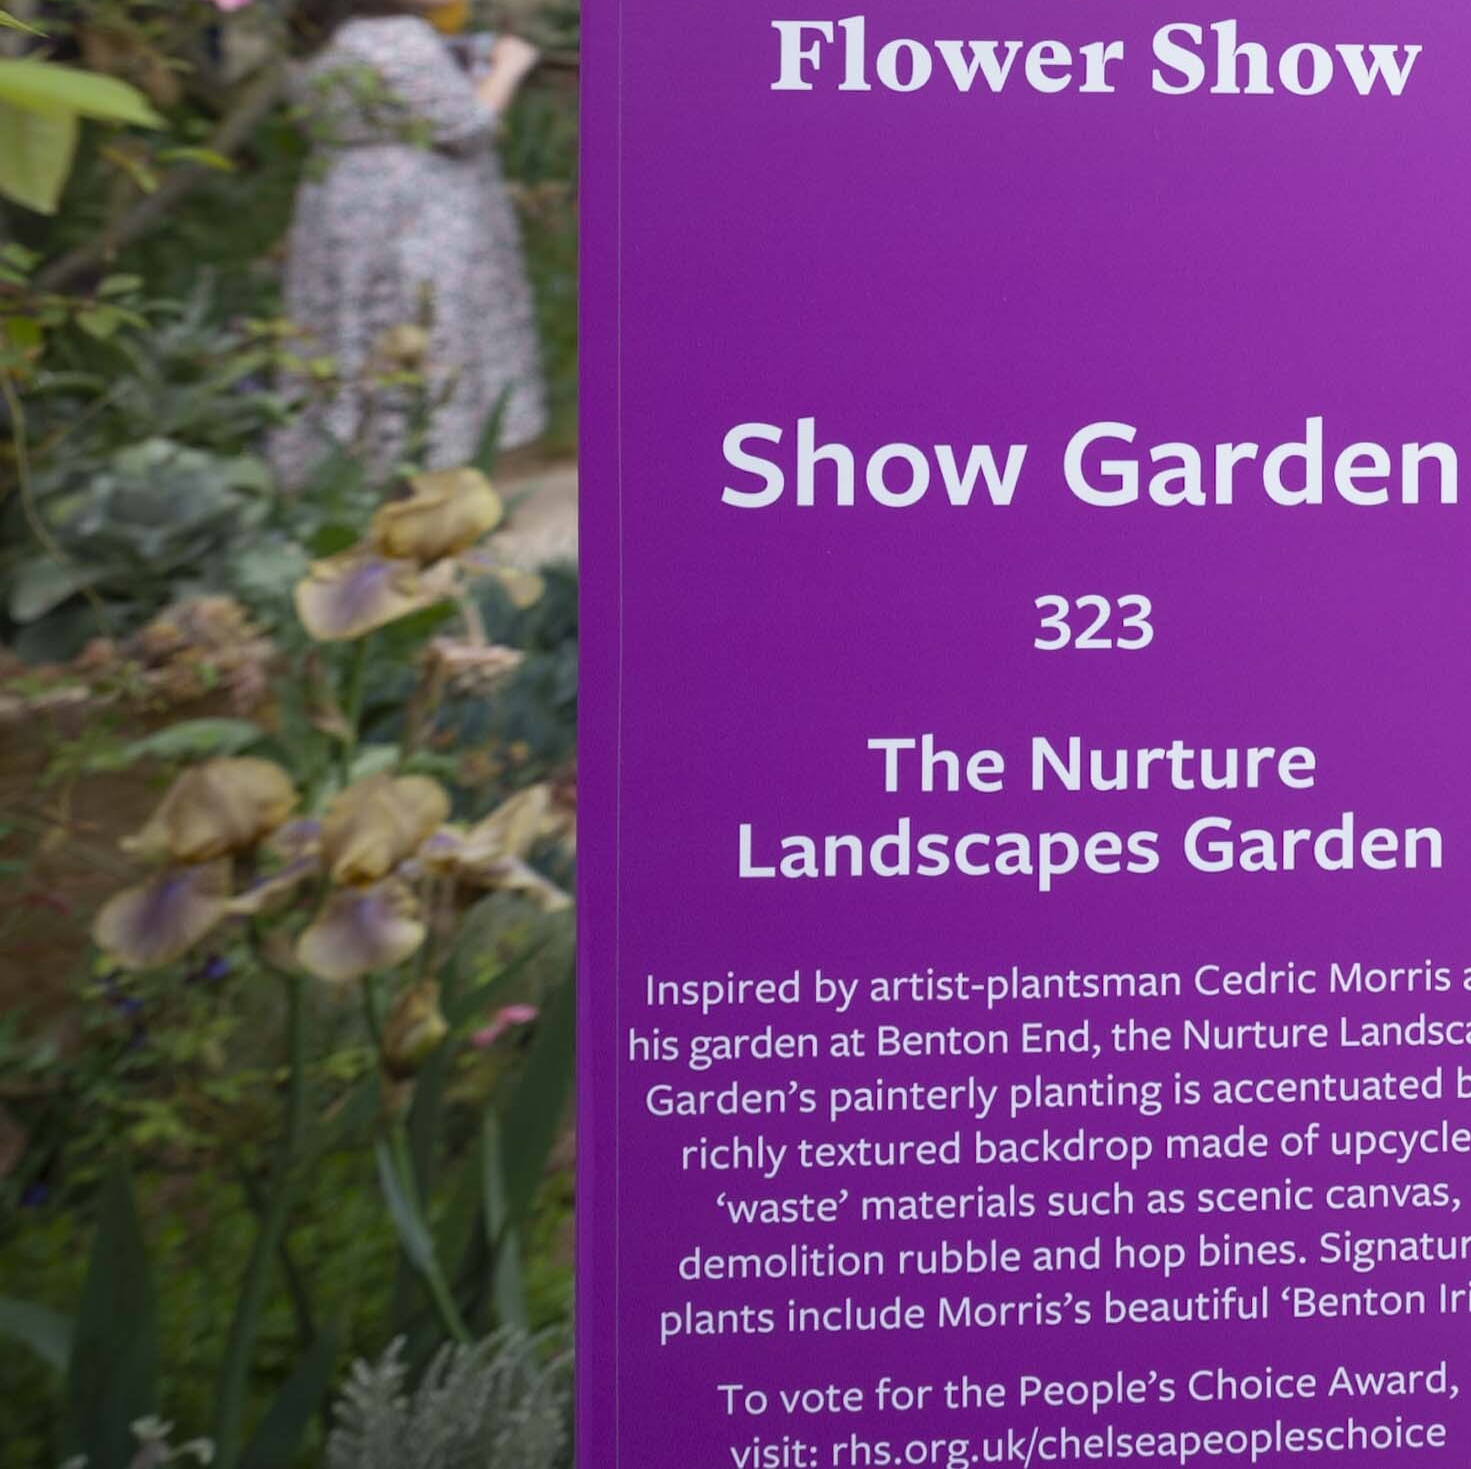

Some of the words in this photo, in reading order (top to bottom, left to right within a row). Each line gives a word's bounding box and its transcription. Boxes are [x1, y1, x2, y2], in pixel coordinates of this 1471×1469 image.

[770, 14, 1125, 94] Flower
[1151, 18, 1423, 97] Show
[720, 416, 1029, 509] Show
[1063, 415, 1458, 508] Garden
[1033, 593, 1155, 651] 323
[867, 732, 1005, 793] The
[1031, 735, 1317, 792] Nurture
[738, 816, 1160, 893] Landscapes
[1183, 810, 1443, 873] Garden
[647, 969, 800, 1016] Inspired
[815, 969, 860, 1013] by
[870, 965, 1181, 1011] artist-plantsman
[1194, 961, 1317, 996] Cedric
[1329, 958, 1452, 993] Morris
[629, 1027, 680, 1062] his
[688, 1024, 818, 1071] garden
[829, 1028, 866, 1058] at
[877, 1025, 1009, 1057] Benton
[1021, 1018, 1102, 1059] End,
[1110, 1017, 1172, 1052] the
[1183, 1018, 1329, 1050] Nurture
[645, 1080, 817, 1117] Garden’s
[830, 1075, 999, 1123] painterly
[1010, 1073, 1163, 1119] planting
[1174, 1071, 1201, 1105] is
[1212, 1065, 1443, 1105] accentuated
[682, 1134, 788, 1179] richly
[797, 1130, 961, 1168] textured
[975, 1127, 1153, 1171] backdrop
[1166, 1124, 1269, 1159] made
[1280, 1121, 1321, 1157] of
[861, 1183, 1036, 1221] materials
[1047, 1181, 1134, 1217] such
[1146, 1189, 1186, 1215] as
[1197, 1177, 1314, 1213] scenic
[1325, 1182, 1461, 1213] canvas,
[678, 1243, 884, 1281] demolition
[899, 1238, 1021, 1275] rubble
[1032, 1236, 1101, 1272] and
[1115, 1235, 1186, 1278] hop
[1199, 1233, 1307, 1267] bines.
[660, 1301, 775, 1347] plants
[788, 1295, 925, 1332] include
[938, 1291, 1092, 1328] Morris’s
[1105, 1285, 1269, 1324] beautiful
[1280, 1285, 1426, 1318] ‘Benton
[716, 1383, 768, 1416] To
[779, 1384, 864, 1414] vote
[874, 1376, 934, 1411] for
[943, 1374, 1006, 1410] the
[1020, 1369, 1176, 1415] People’s
[1188, 1365, 1317, 1402] Choice
[1327, 1360, 1460, 1400] Award,
[729, 1435, 818, 1469] visit:
[832, 1415, 1447, 1469] rhs.org.uk/chelseapeopleschoice
